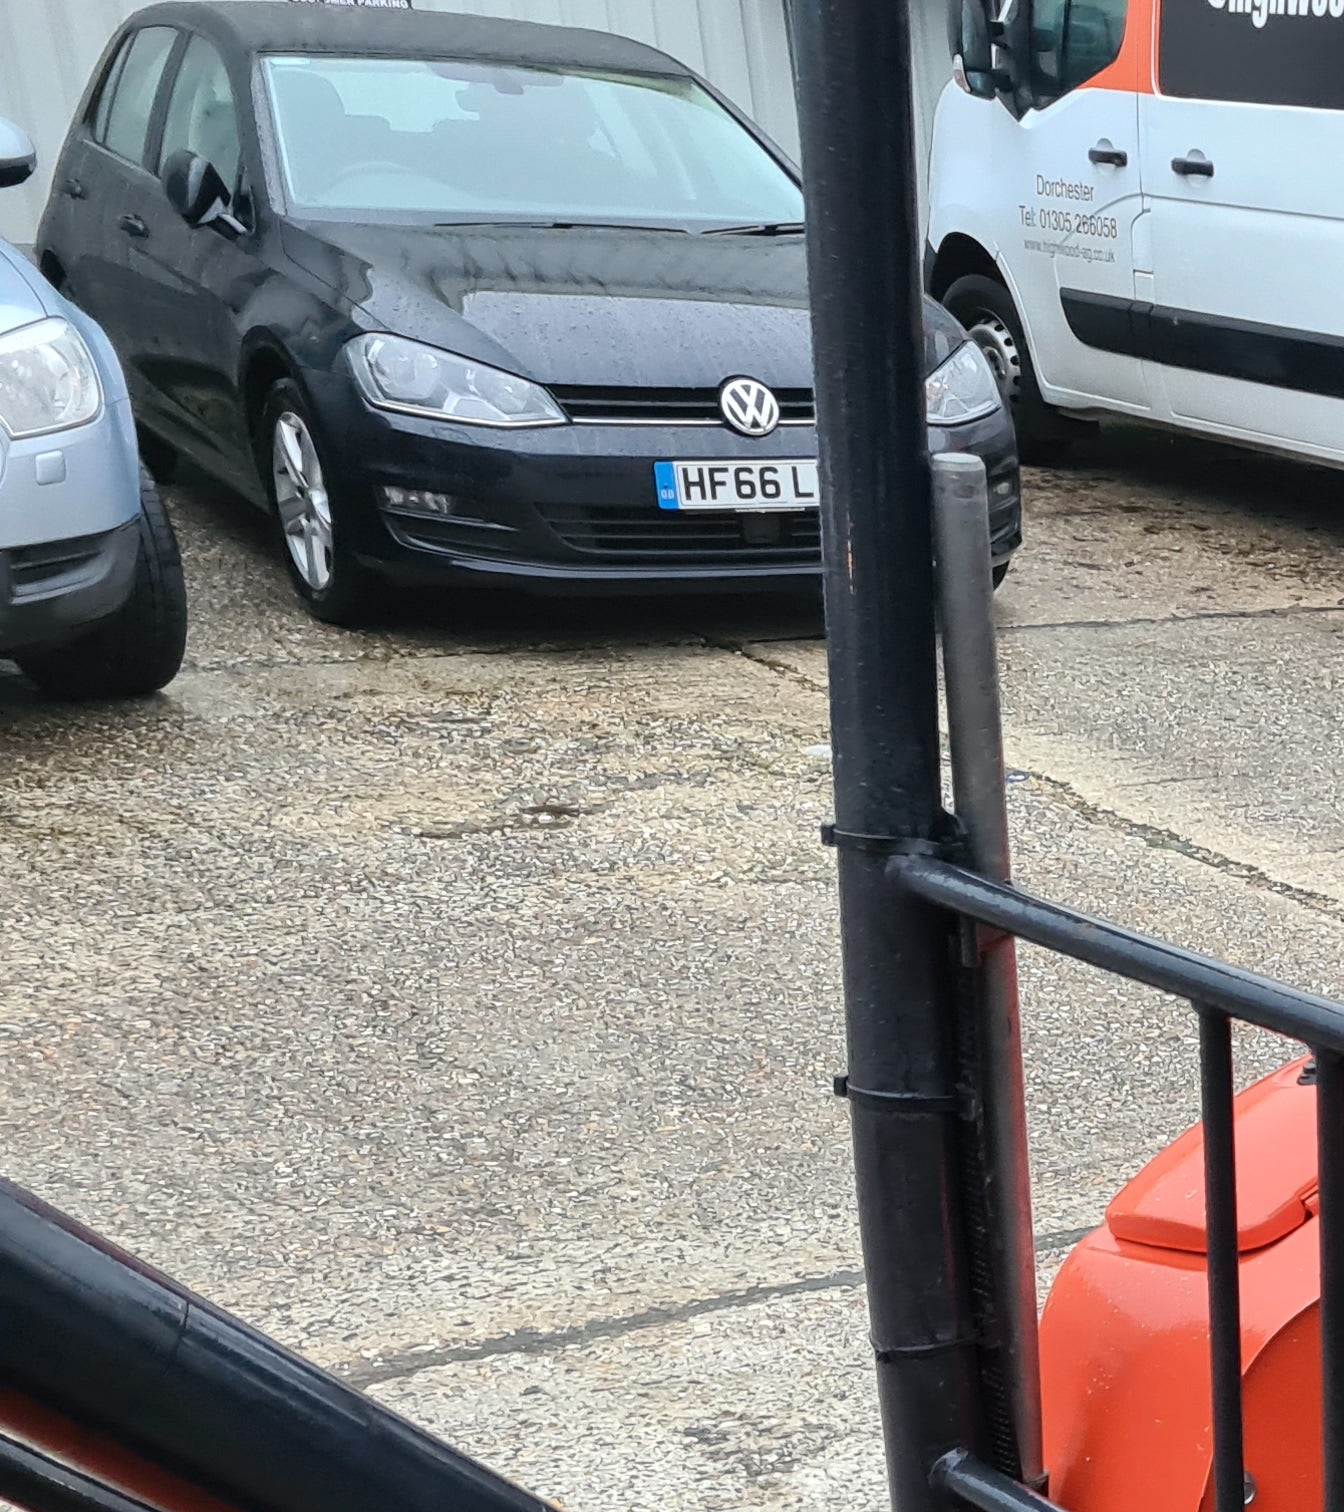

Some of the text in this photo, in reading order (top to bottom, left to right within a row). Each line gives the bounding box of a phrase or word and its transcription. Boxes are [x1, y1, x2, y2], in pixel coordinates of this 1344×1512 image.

[1036, 173, 1095, 202] Dorchester
[1039, 207, 1073, 233] 01305
[1074, 212, 1118, 239] 266058
[681, 465, 815, 501] HF66 L
